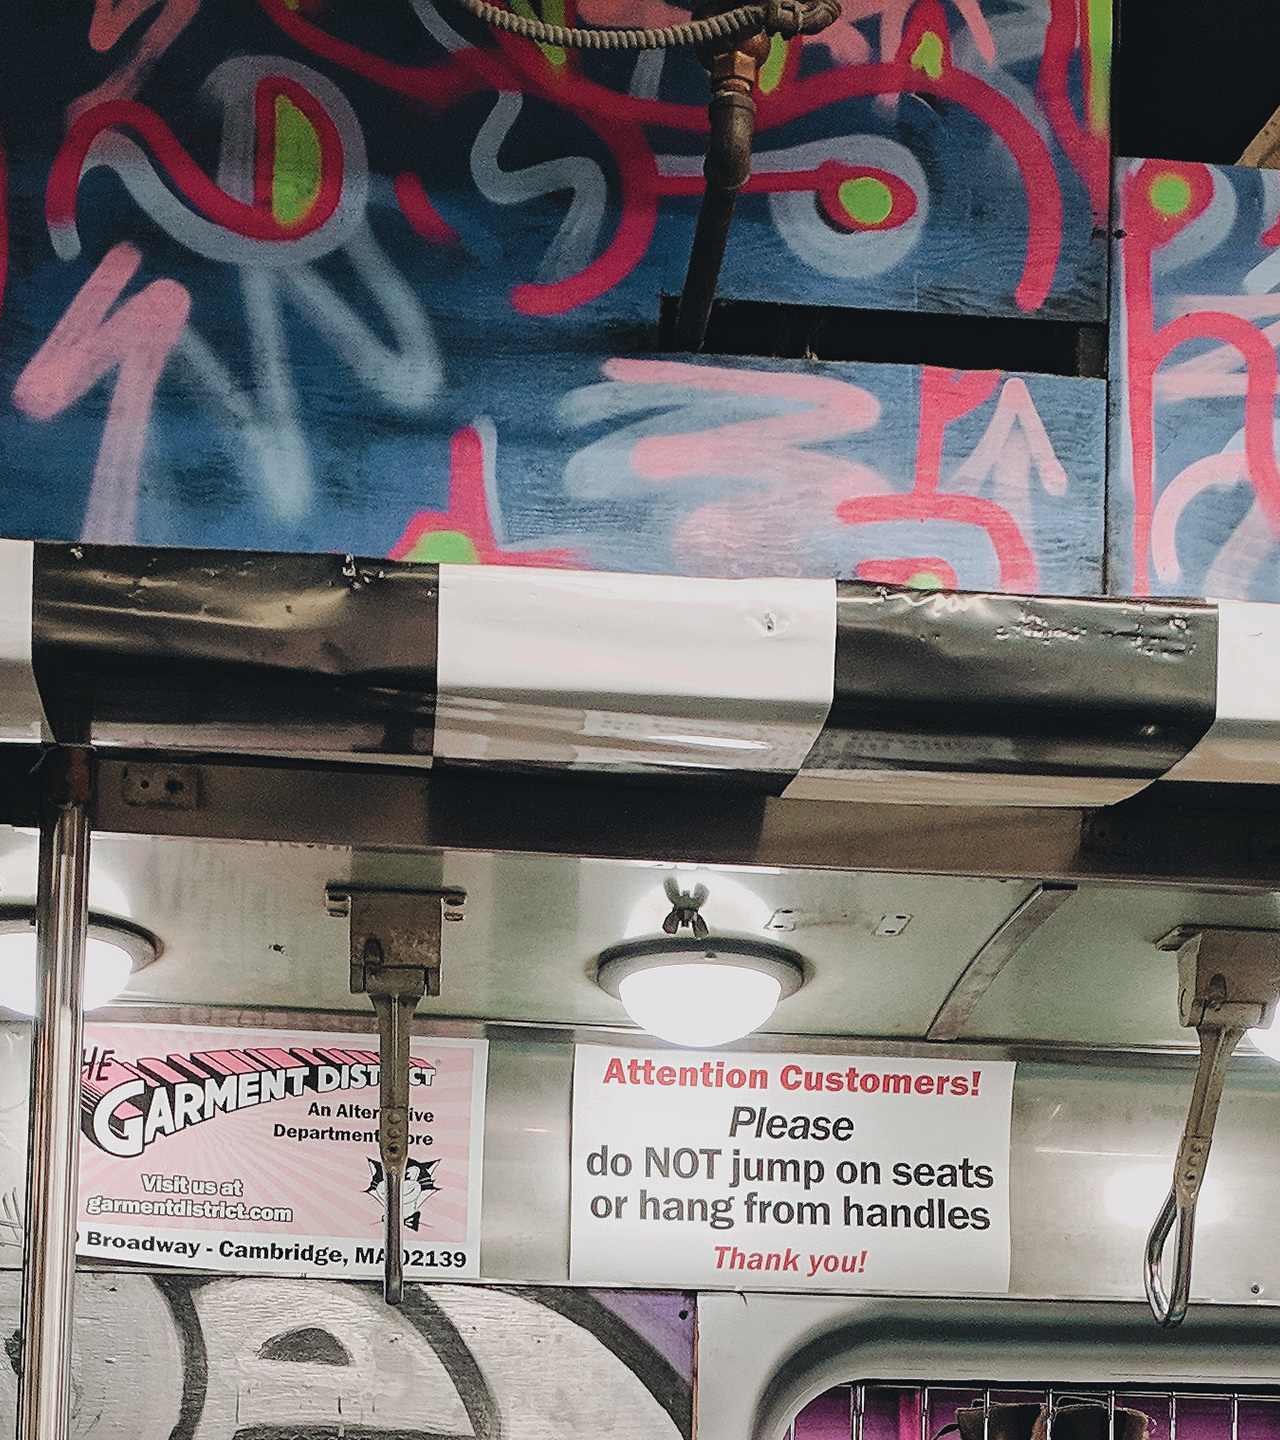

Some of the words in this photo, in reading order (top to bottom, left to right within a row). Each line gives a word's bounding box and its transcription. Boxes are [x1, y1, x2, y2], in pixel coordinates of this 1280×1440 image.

[82, 1046, 116, 1081] HE
[602, 1057, 769, 1090] Attention
[780, 1064, 982, 1097] Customers!
[93, 1065, 310, 1158] GARMENT
[318, 1063, 437, 1093] DISTCT
[308, 1102, 332, 1117] An
[728, 1105, 855, 1142] Please
[141, 1173, 190, 1194] Visit
[191, 1178, 217, 1196] us
[220, 1178, 244, 1197] at
[586, 1145, 633, 1178] do
[644, 1147, 722, 1180] NOT
[729, 1150, 825, 1190] jump
[836, 1159, 882, 1186] on
[892, 1158, 995, 1189] seats
[86, 1194, 294, 1223] garmentdistrict.com
[589, 1193, 628, 1219] or
[639, 1190, 735, 1230] hang
[744, 1191, 831, 1226] from
[843, 1195, 991, 1231] handles
[86, 1230, 201, 1259] Broadway
[219, 1239, 349, 1268] Cambridge,
[713, 1245, 800, 1272] Thank
[806, 1250, 868, 1278] you!
